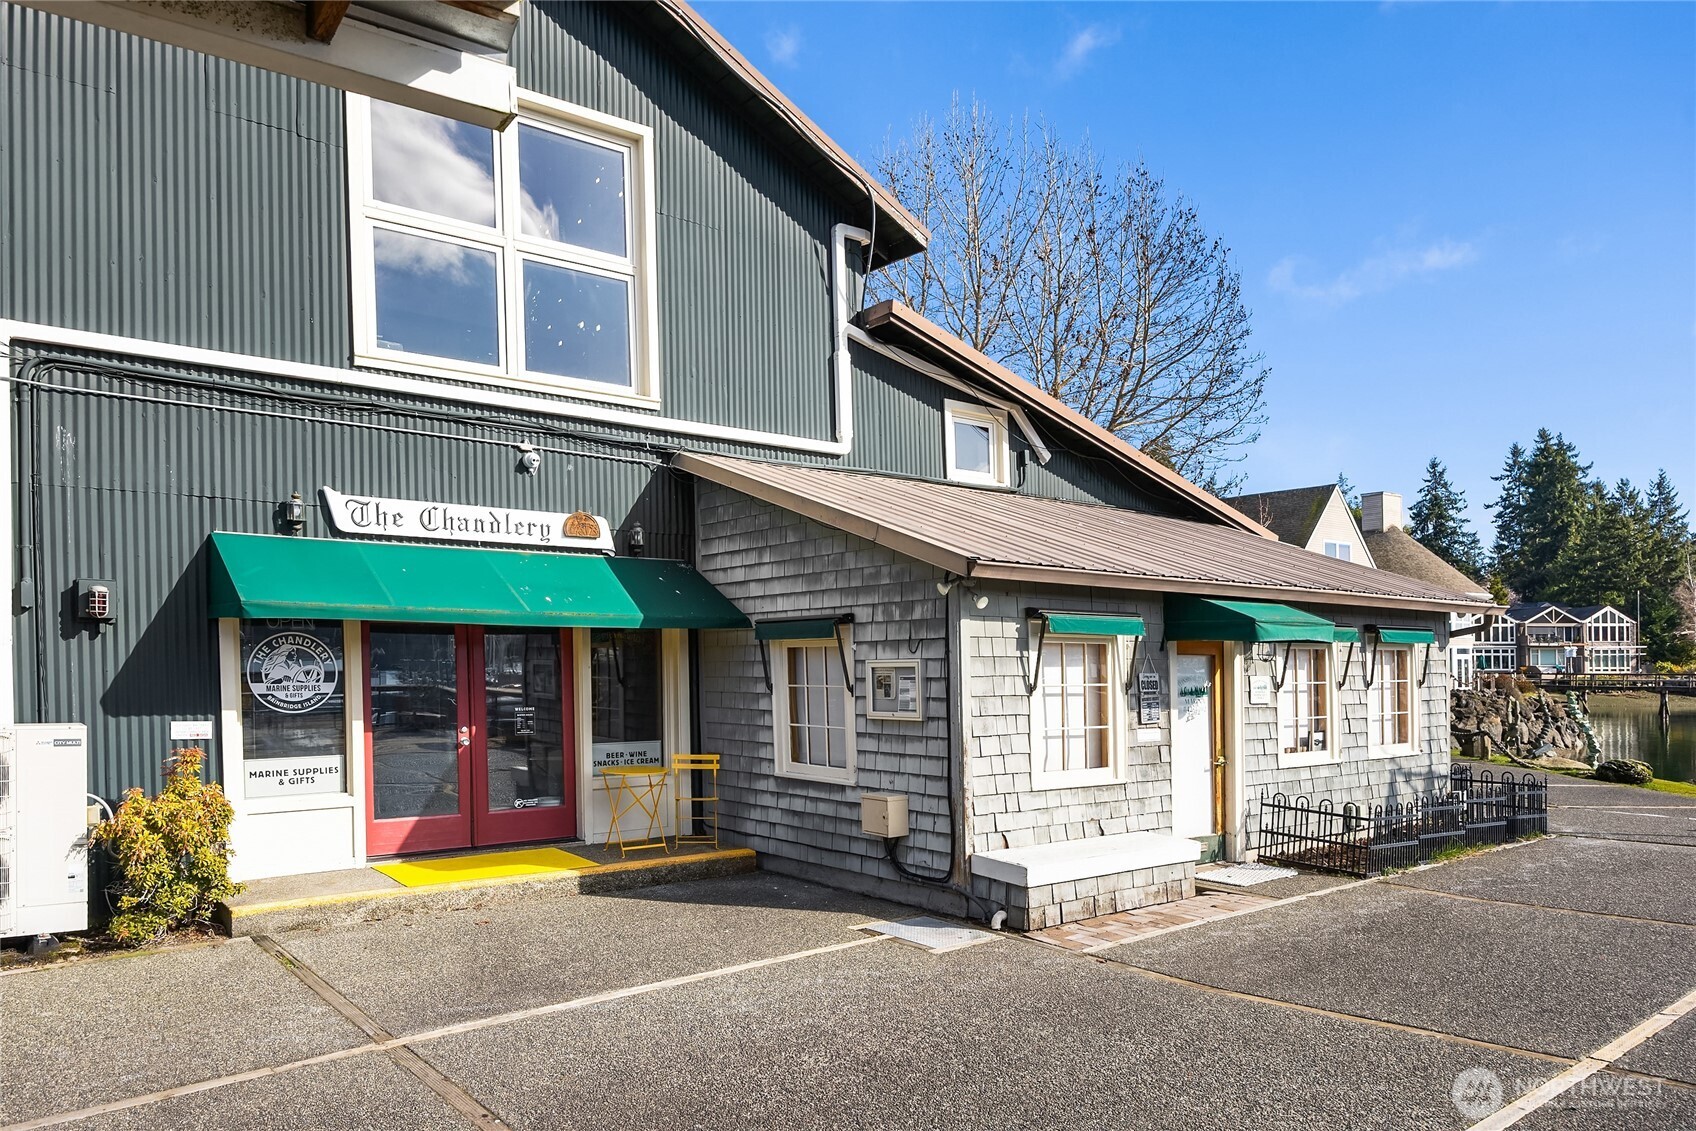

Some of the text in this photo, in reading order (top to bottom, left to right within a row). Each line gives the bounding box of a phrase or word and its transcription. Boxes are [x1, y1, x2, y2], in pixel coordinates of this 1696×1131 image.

[345, 499, 552, 543] The Chandlery
[253, 636, 333, 665] THE CHANDLERY
[266, 684, 321, 692] MARINE SUPPLIES
[266, 694, 322, 709] BAINBRIDGE ISLAND
[606, 750, 647, 759] BEER WINE
[249, 766, 339, 778] MARINE SUPPLIES
[288, 776, 315, 785] GIFTS
